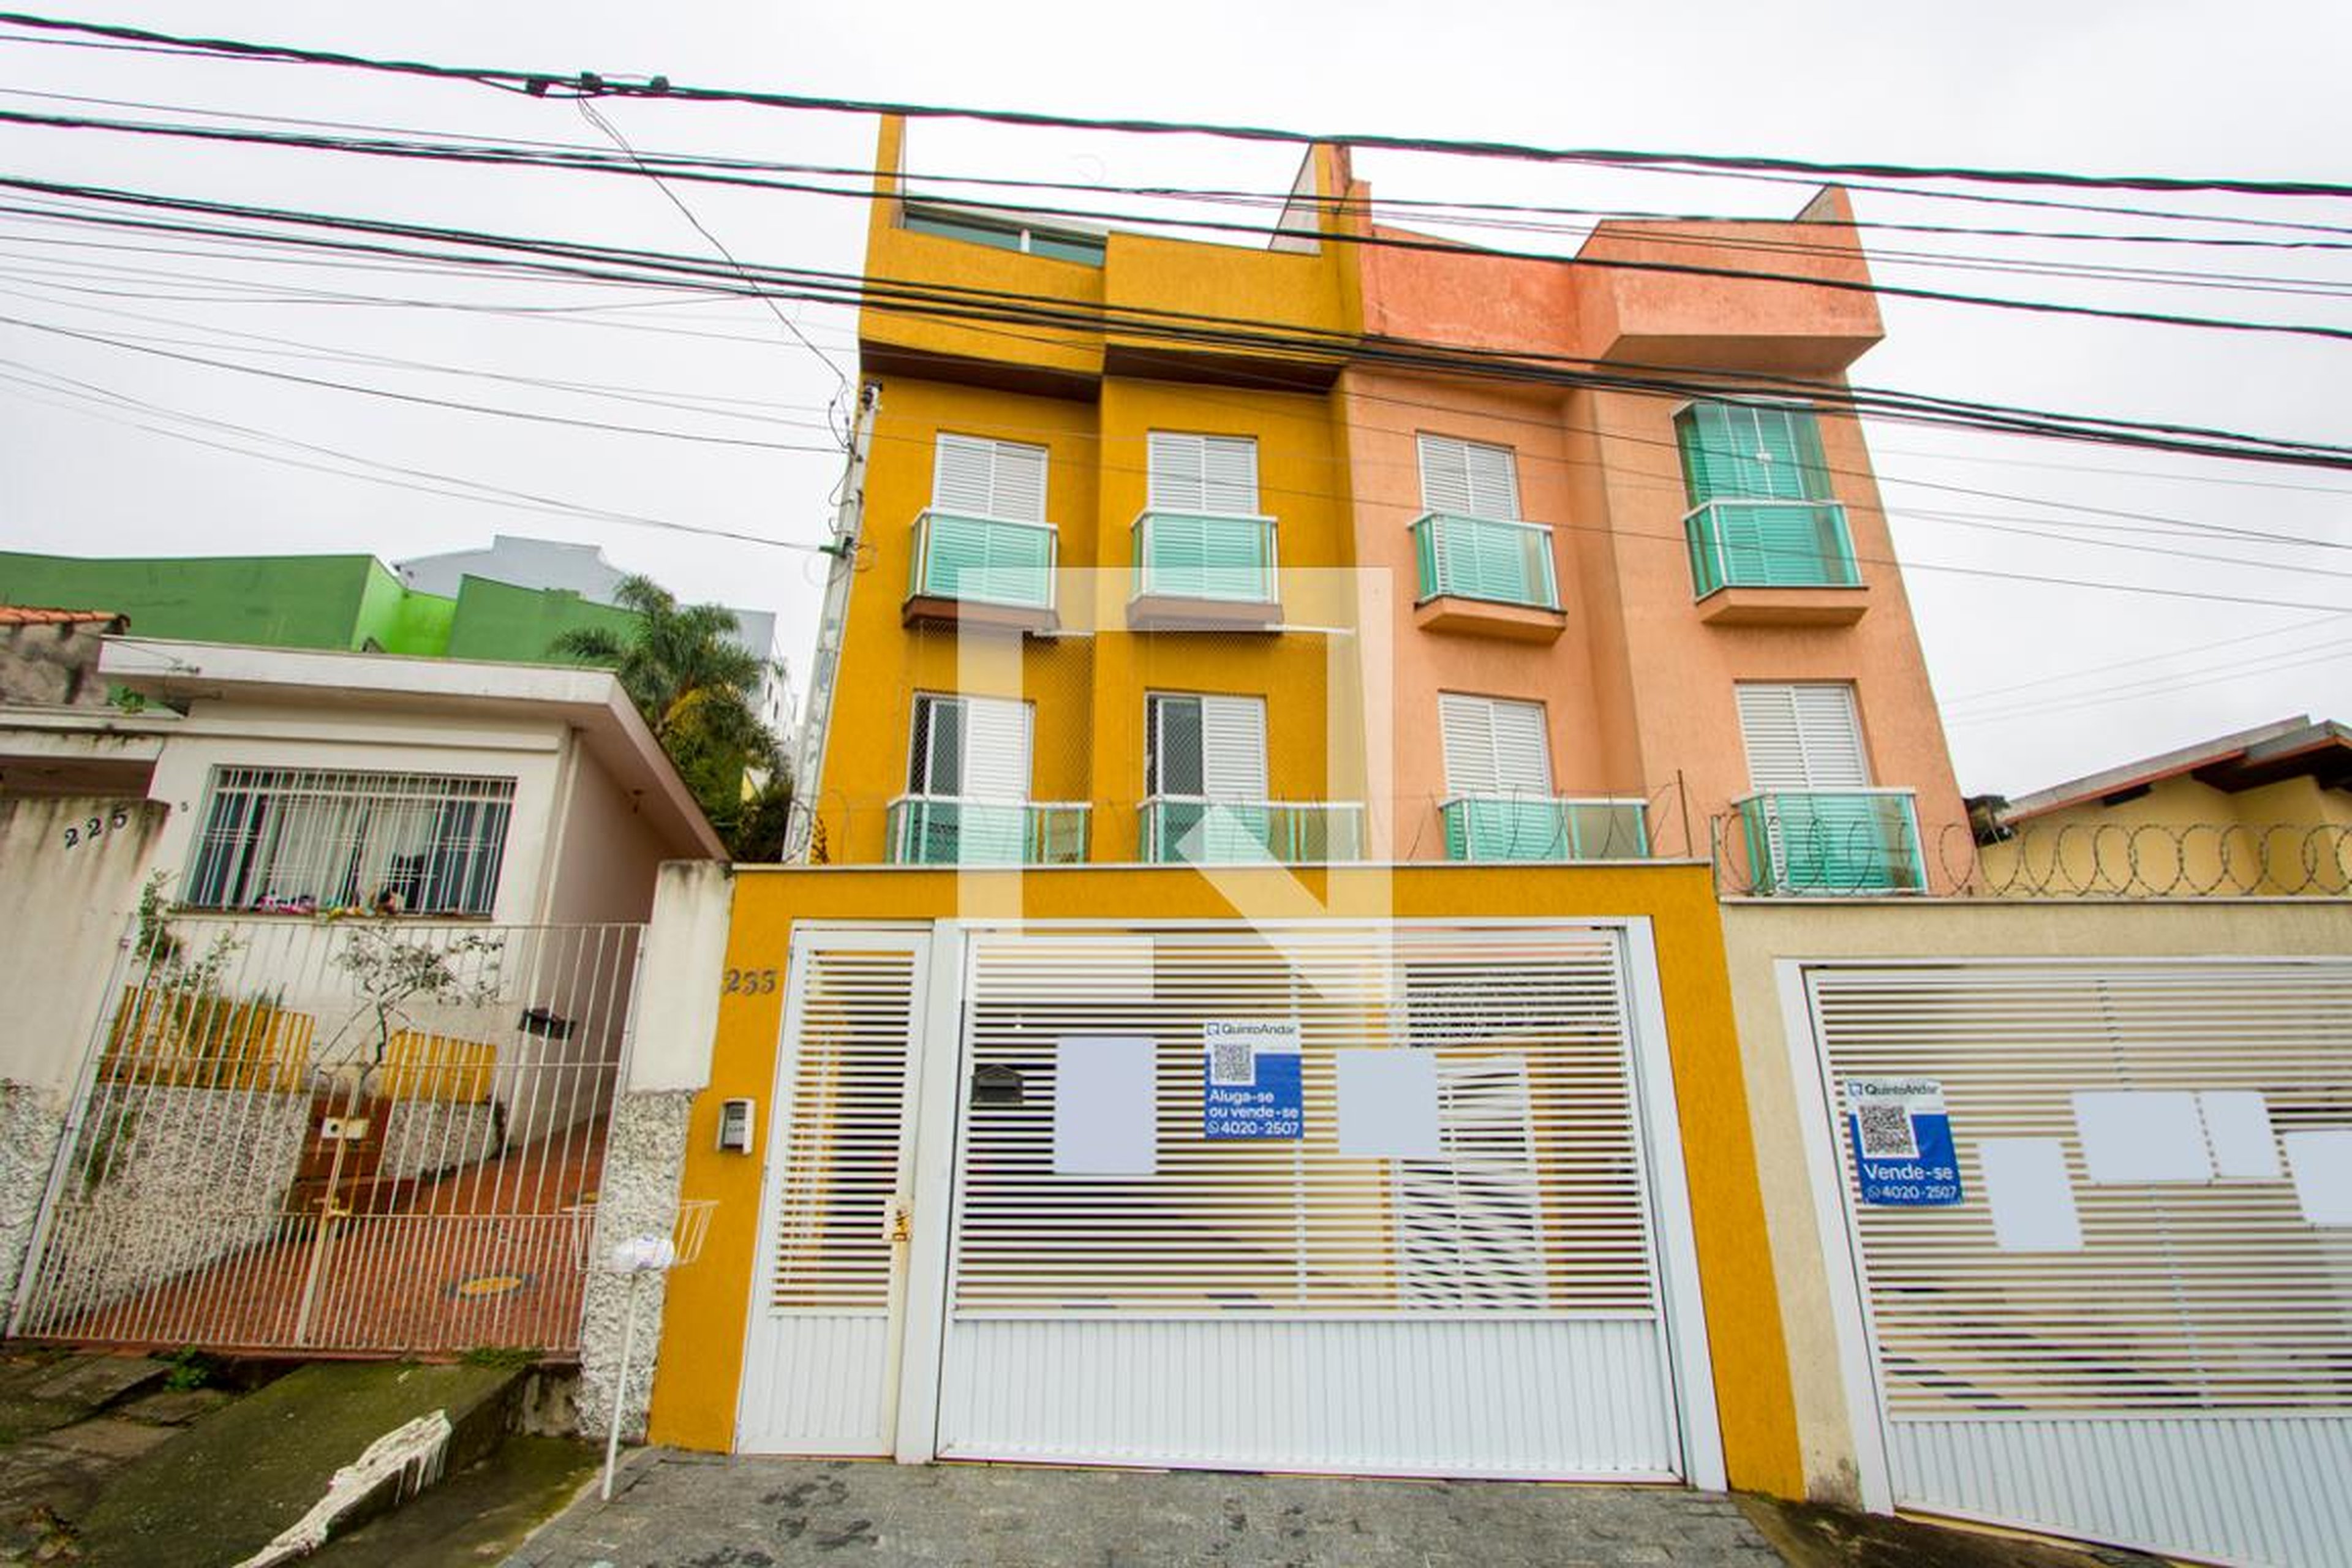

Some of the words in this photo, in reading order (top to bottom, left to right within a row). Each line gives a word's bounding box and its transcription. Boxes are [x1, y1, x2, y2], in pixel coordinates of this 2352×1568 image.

[65, 804, 127, 850] 225
[1222, 1023, 1295, 1035] QuintoAndar
[1864, 1083, 1938, 1095] QuintoAndar
[1209, 1090, 1275, 1104] Aluga-se
[1209, 1108, 1227, 1118] ou
[1231, 1106, 1298, 1118] vende-se
[1221, 1121, 1299, 1134] 4020-2507
[1863, 1164, 1954, 1181] Vende-se
[1882, 1186, 1958, 1199] 4020-2507
